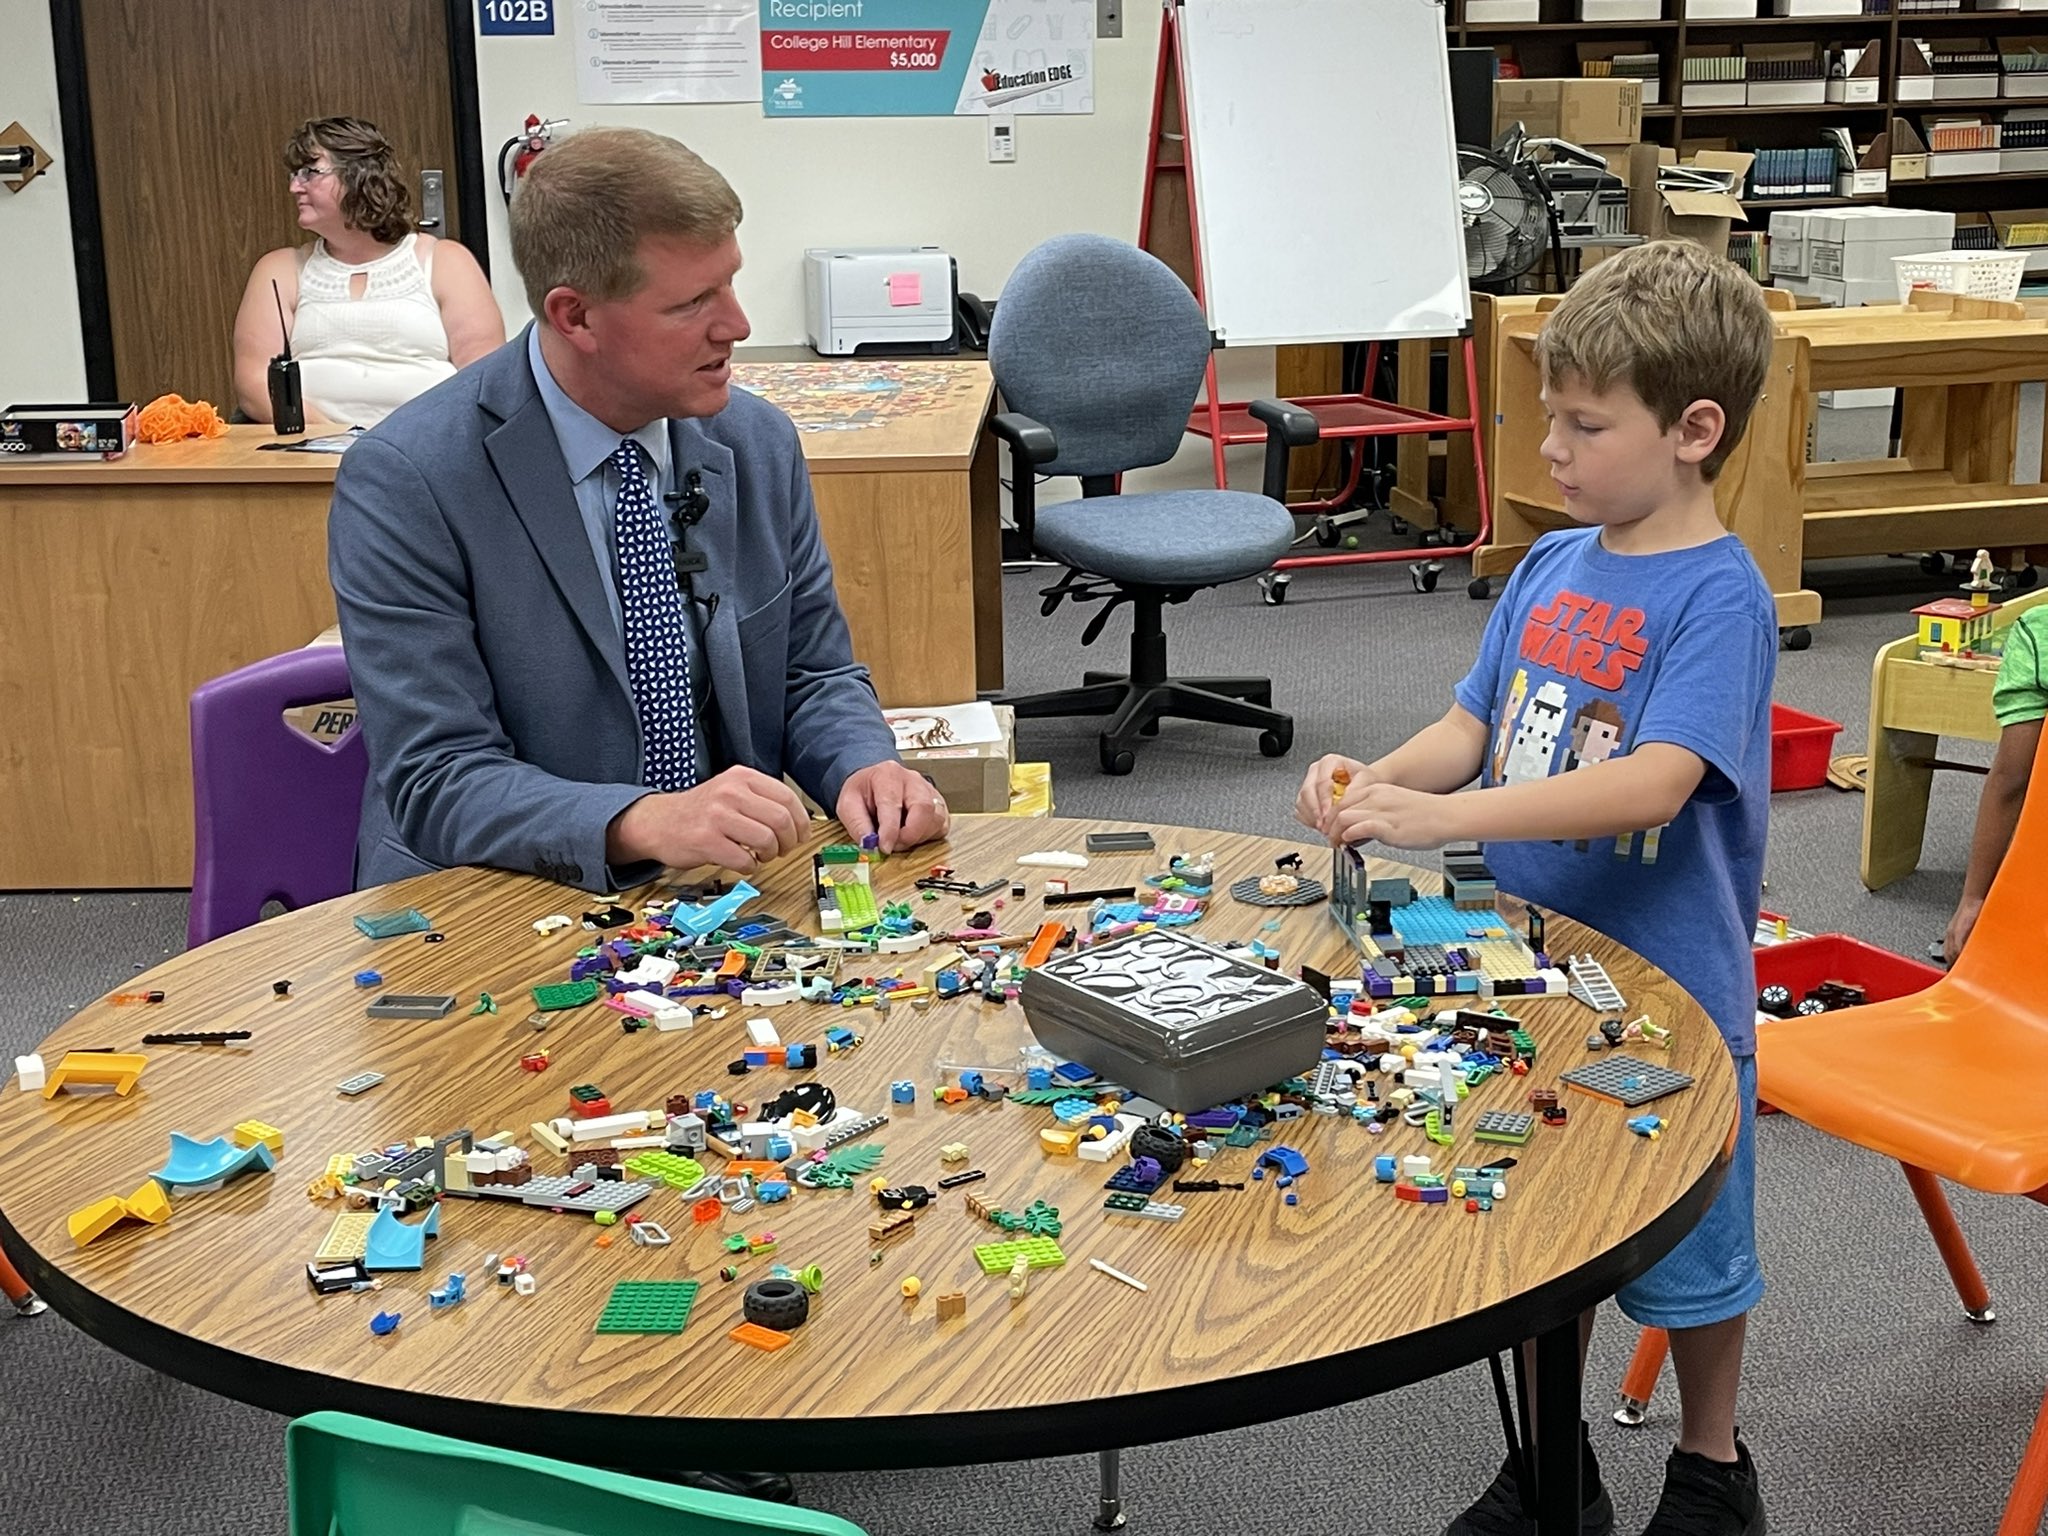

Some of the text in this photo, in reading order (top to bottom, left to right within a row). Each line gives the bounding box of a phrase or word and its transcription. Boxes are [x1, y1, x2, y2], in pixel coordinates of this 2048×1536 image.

[485, 0, 548, 21] 102B
[770, 0, 864, 21] Recipient
[770, 35, 937, 51] College Hill Elementary
[890, 52, 937, 68] $5,000
[992, 64, 1073, 90] Education EDGE
[1530, 590, 1649, 655] STAR
[1520, 621, 1643, 691] WARS
[310, 711, 359, 735] PER
